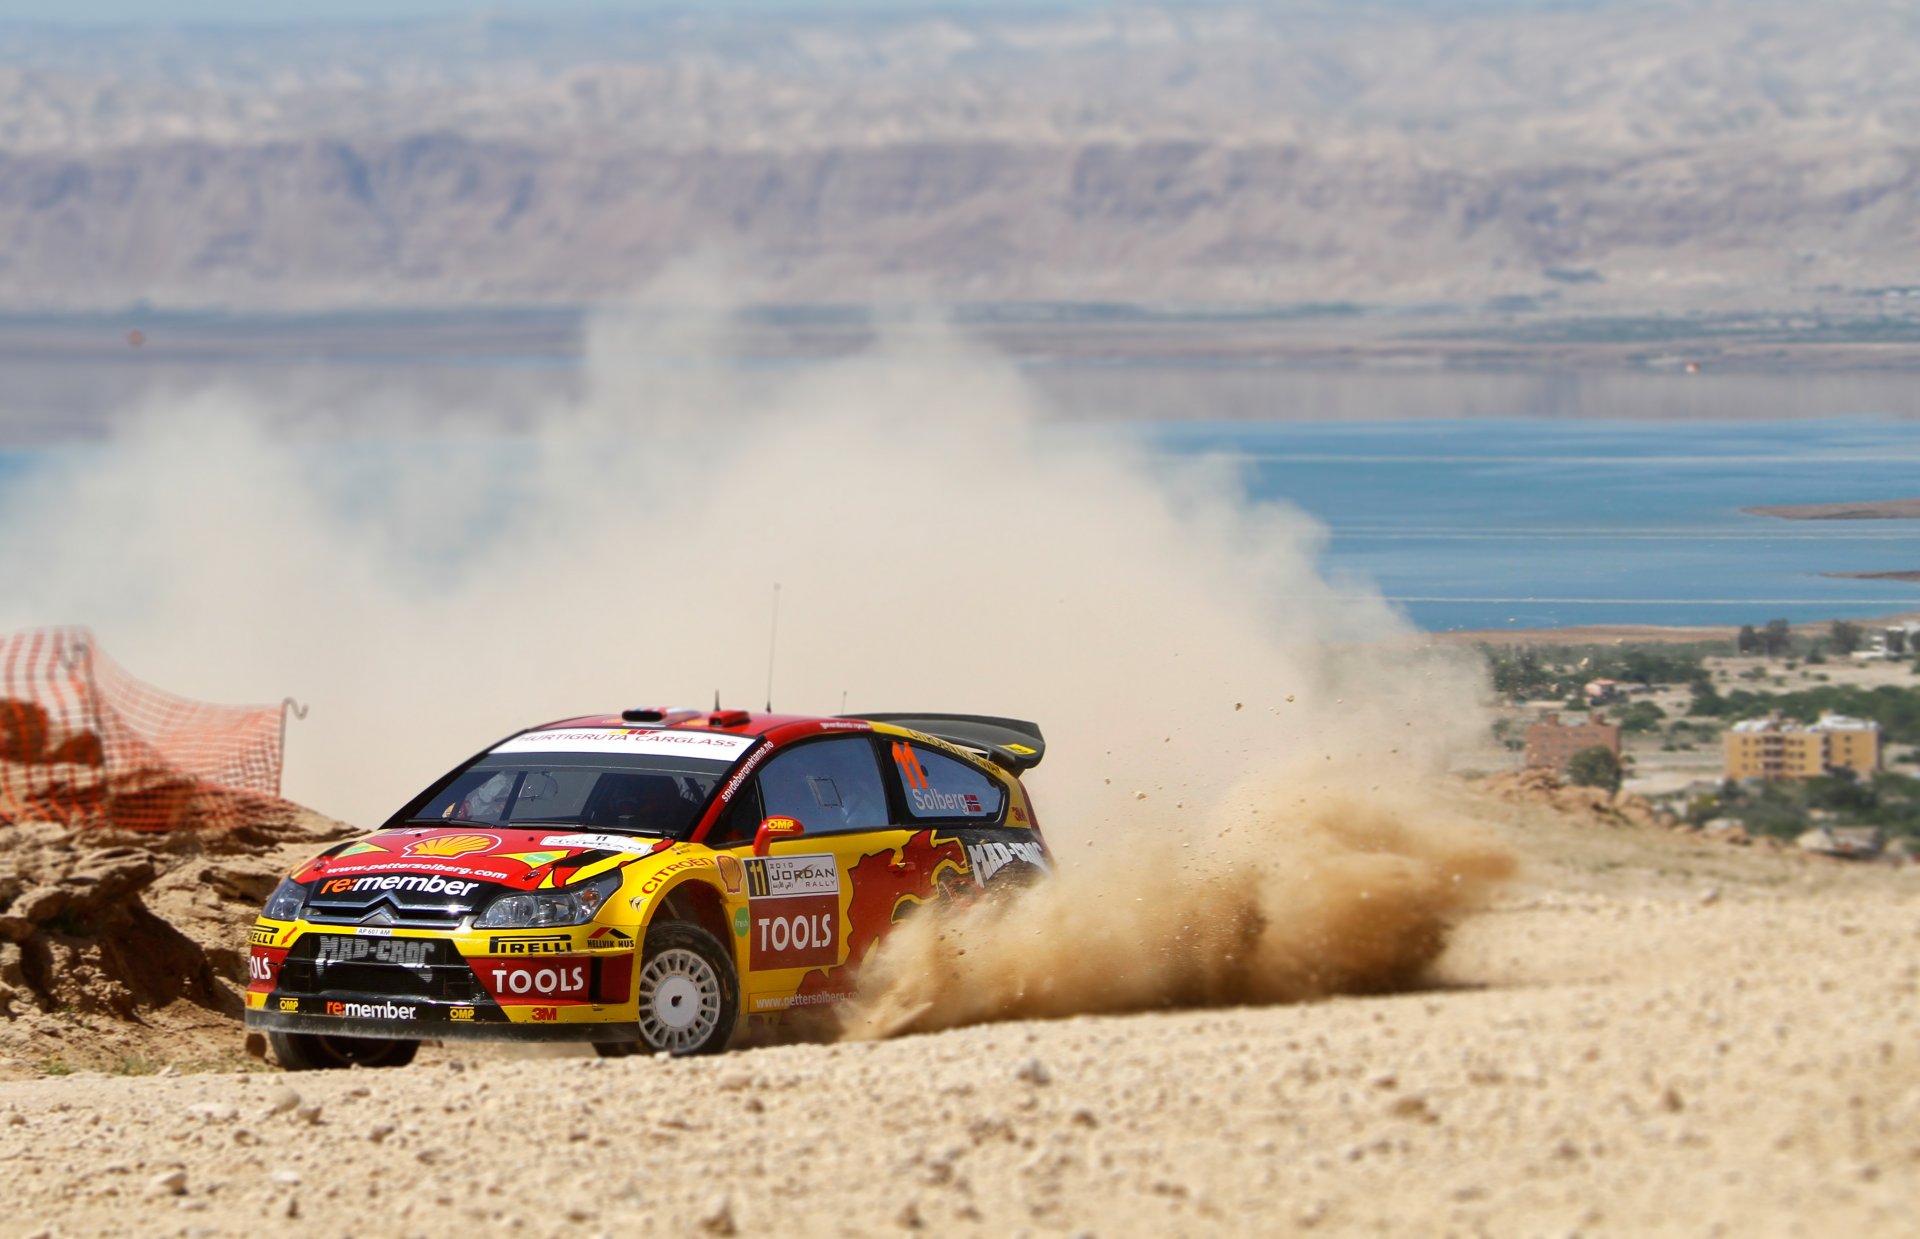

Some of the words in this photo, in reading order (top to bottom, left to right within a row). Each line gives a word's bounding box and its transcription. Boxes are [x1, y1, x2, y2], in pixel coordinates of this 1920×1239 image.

[521, 733, 627, 742] HURTIGRUTA
[635, 735, 738, 747] CARGLASS
[892, 741, 928, 789] 11
[912, 788, 969, 814] Solberg
[768, 820, 794, 830] OMP
[326, 862, 508, 880] www.pettersolberg.com
[641, 857, 715, 894] CITROËN
[749, 860, 768, 896] 11
[771, 868, 835, 882] JORDAN
[320, 874, 480, 897] re:member
[758, 913, 832, 952] TOOLS
[489, 934, 572, 954] PIRELLI
[618, 939, 635, 948] HUS
[249, 955, 271, 980] OLS
[492, 966, 584, 994] TOOLS
[280, 1000, 299, 1011] OMP
[326, 1001, 417, 1020] re:member
[756, 992, 859, 1010] www.pettersolberg.co
[450, 1008, 475, 1019] OMP
[531, 1008, 558, 1020] 3M
